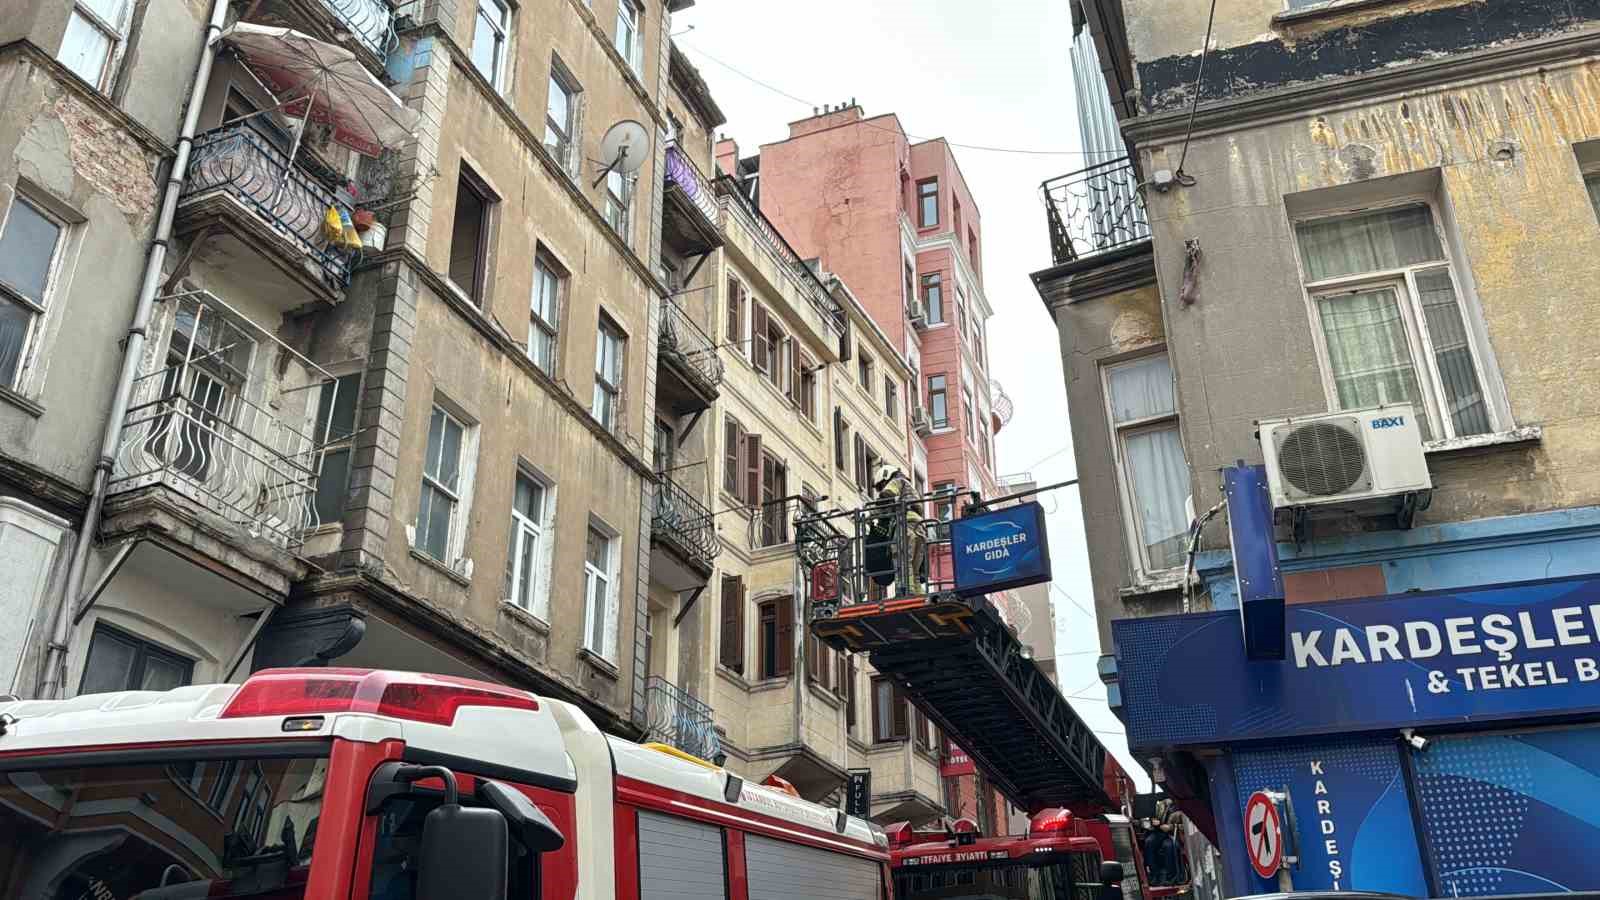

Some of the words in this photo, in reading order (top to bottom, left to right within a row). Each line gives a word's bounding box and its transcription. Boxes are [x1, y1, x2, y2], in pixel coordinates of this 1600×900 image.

[1372, 416, 1404, 429] BAXI
[966, 532, 1026, 555] KARDEŞLER
[984, 548, 1010, 561] GIDA
[1427, 670, 1450, 694] &
[1456, 661, 1569, 691] TEKEL
